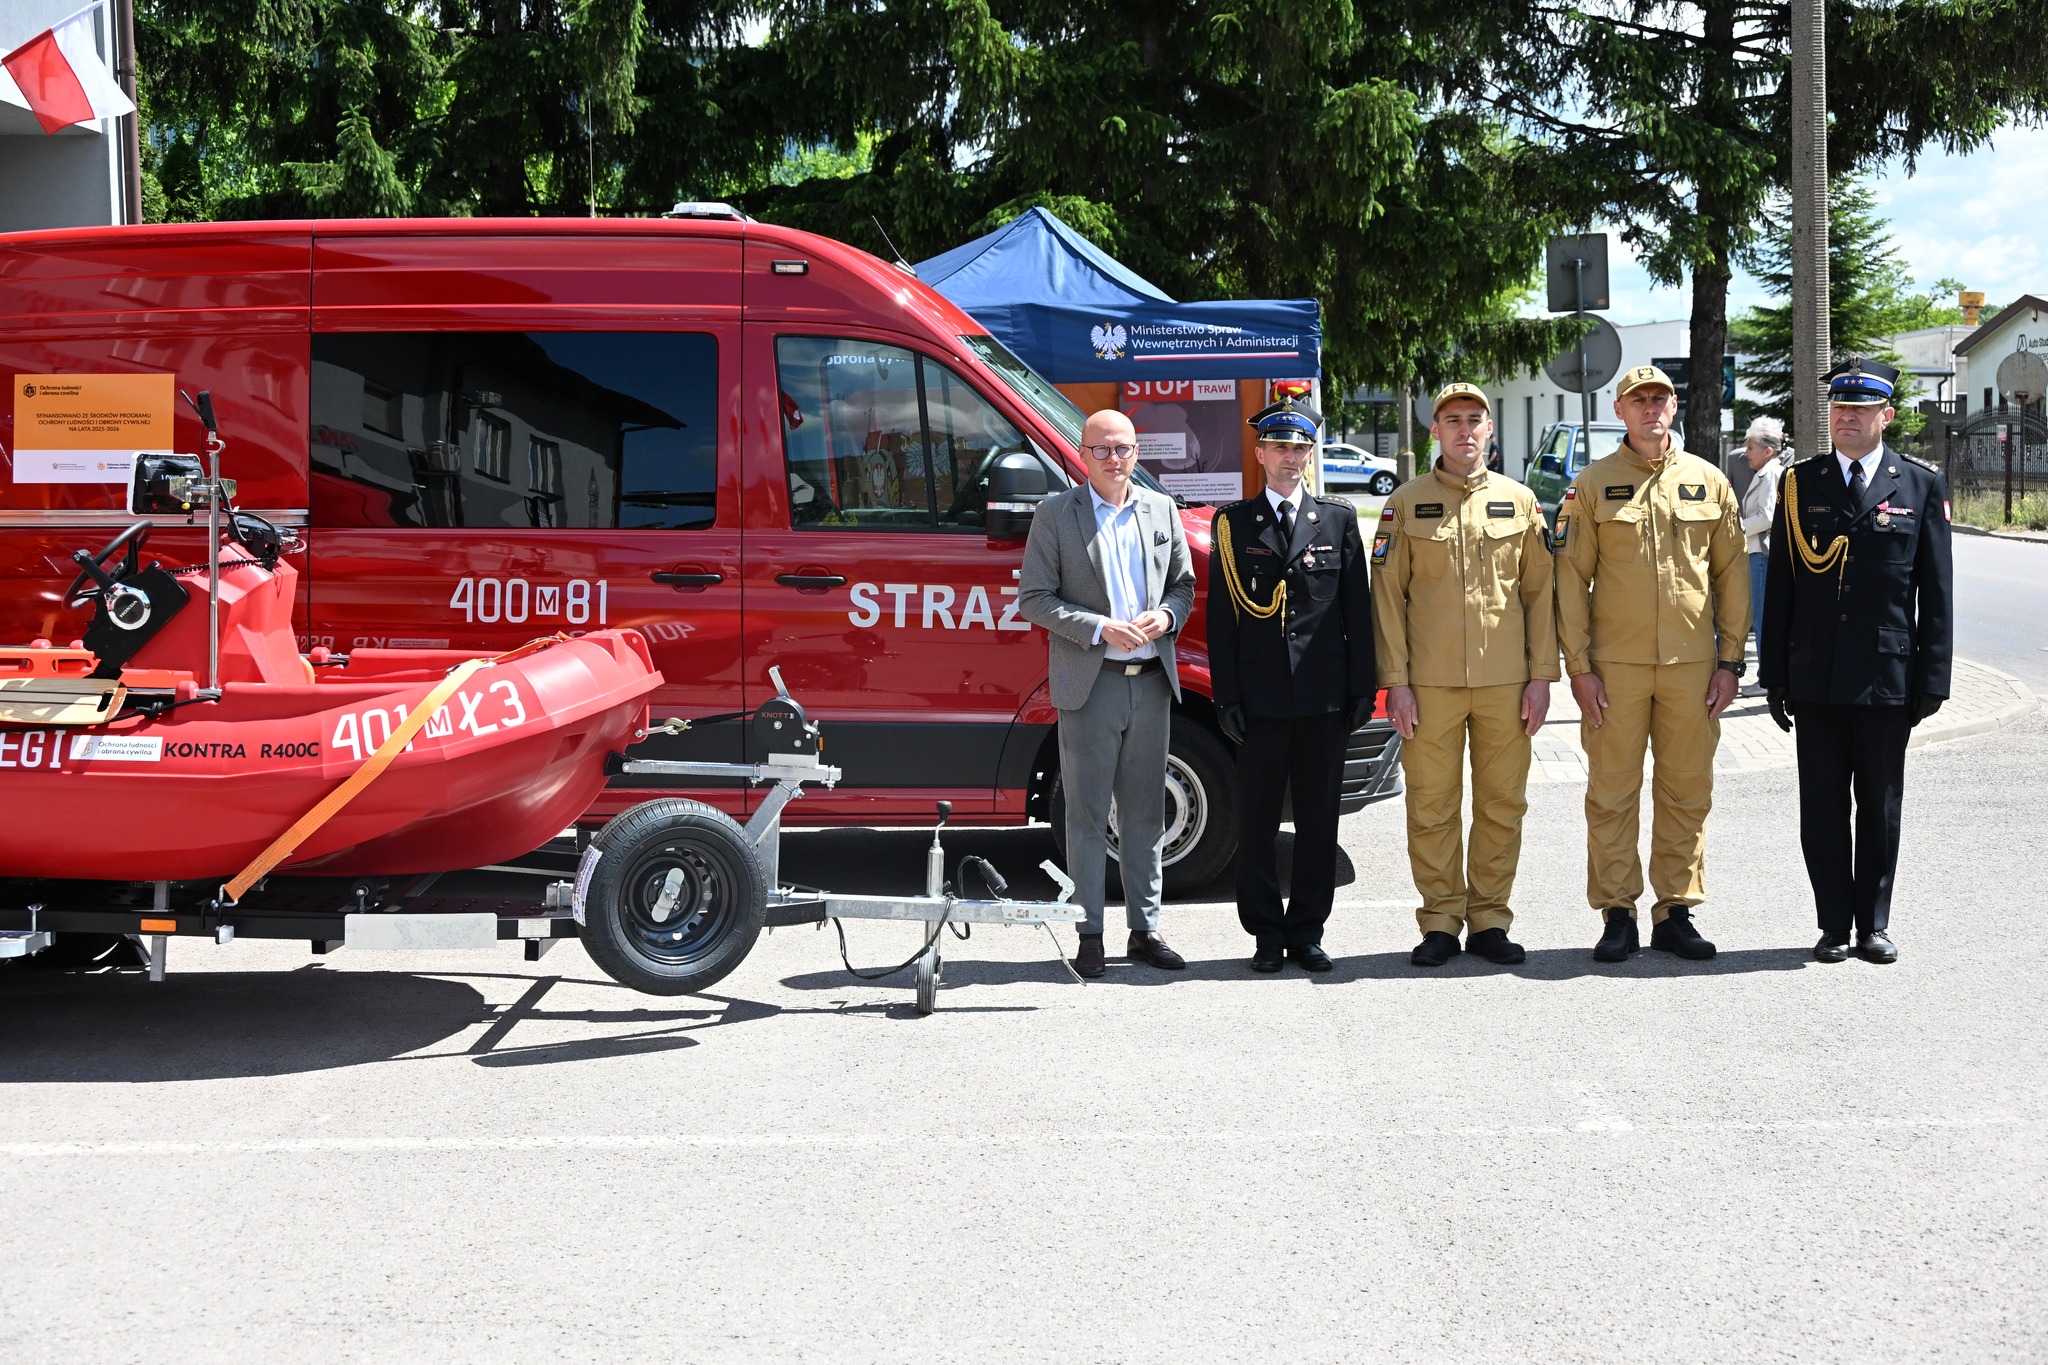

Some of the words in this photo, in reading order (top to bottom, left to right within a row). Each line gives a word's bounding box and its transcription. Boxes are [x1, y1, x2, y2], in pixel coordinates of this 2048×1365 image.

[1131, 325, 1205, 335] Ministerstwo
[1207, 325, 1242, 336] Spraw
[1131, 338, 1216, 350] Wewnętrznych
[1220, 338, 1223, 347] i
[1226, 335, 1299, 348] Administracji
[1127, 381, 1189, 395] STOP
[1197, 384, 1232, 394] TRAW!
[450, 577, 530, 624] 400
[566, 579, 608, 625] 81
[119, 600, 138, 618] HONDA
[761, 711, 789, 719] KNOTT
[164, 742, 247, 758] KONTRA
[260, 742, 320, 758] R400C
